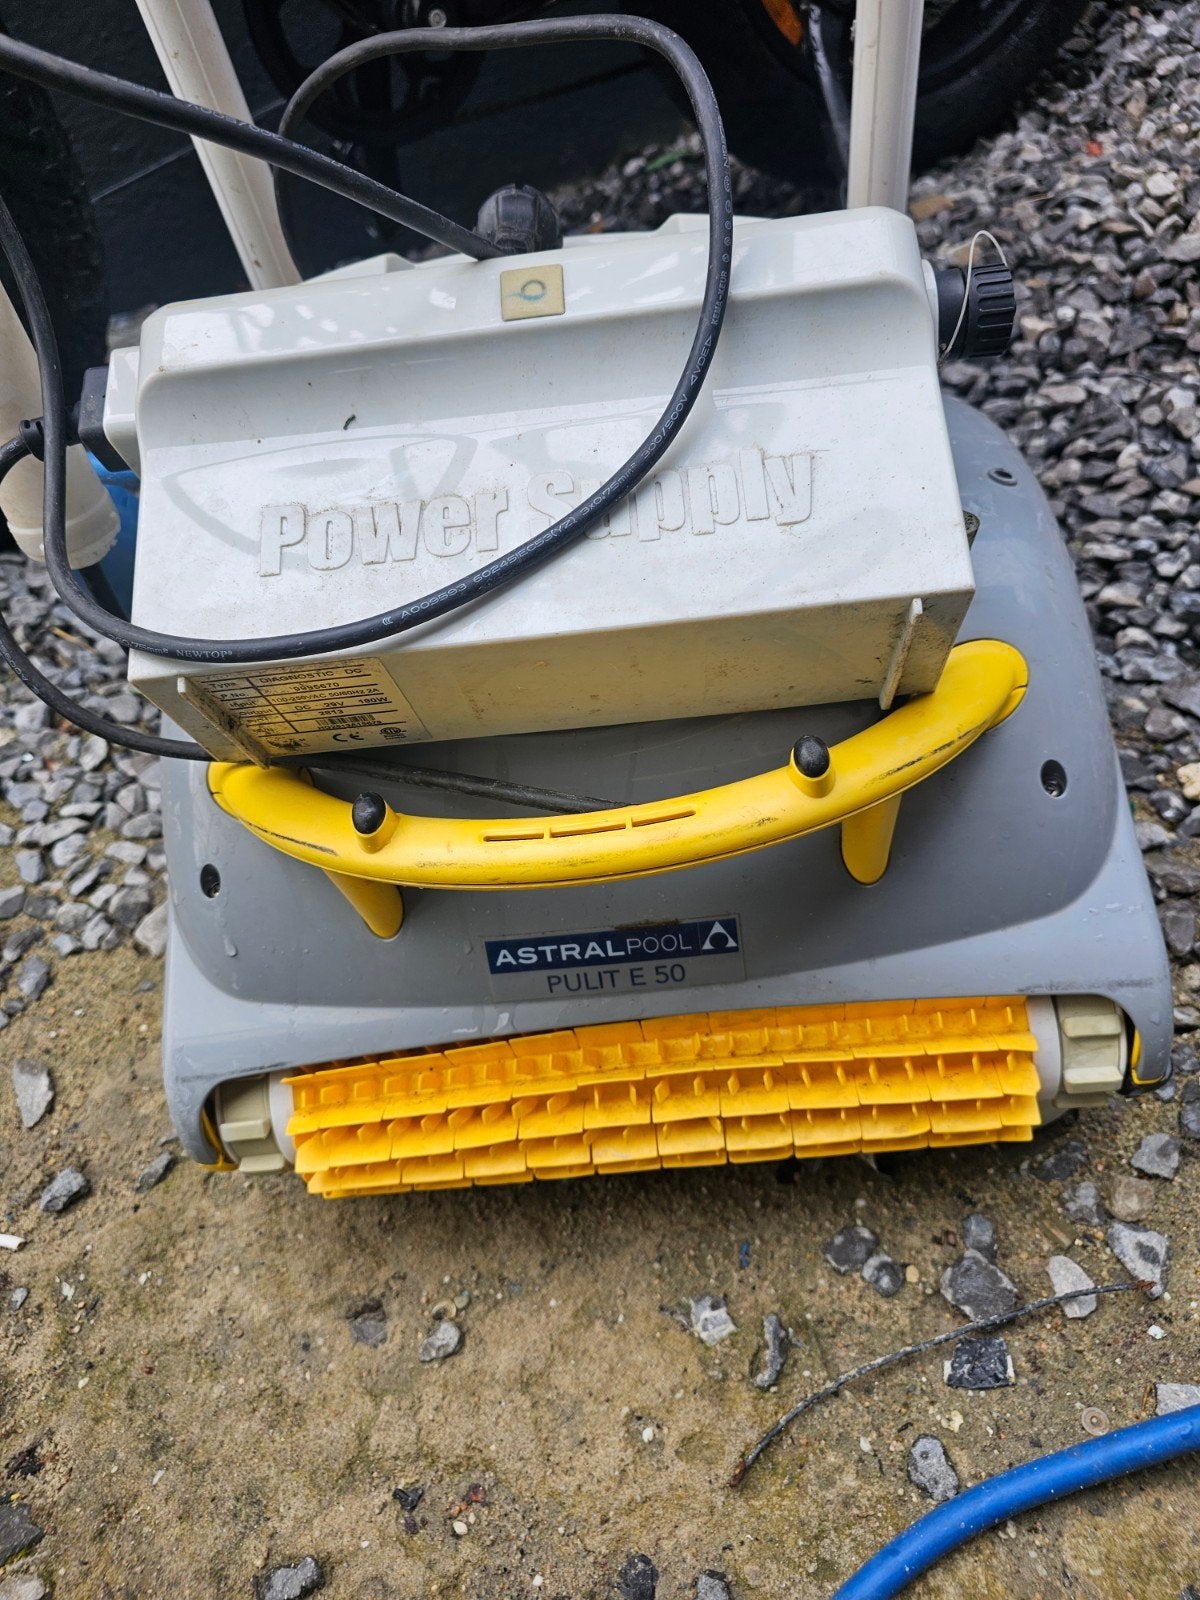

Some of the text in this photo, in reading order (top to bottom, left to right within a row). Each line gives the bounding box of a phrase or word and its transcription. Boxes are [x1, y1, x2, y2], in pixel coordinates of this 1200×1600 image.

[401, 583, 467, 620] A009593
[641, 393, 688, 459] 300/500V
[260, 487, 508, 578] Power
[258, 671, 335, 684] DIAGNOSTIC
[343, 667, 363, 676] DC
[495, 933, 693, 967] ASTRALPOOL
[546, 963, 686, 994] PULIT E 50
